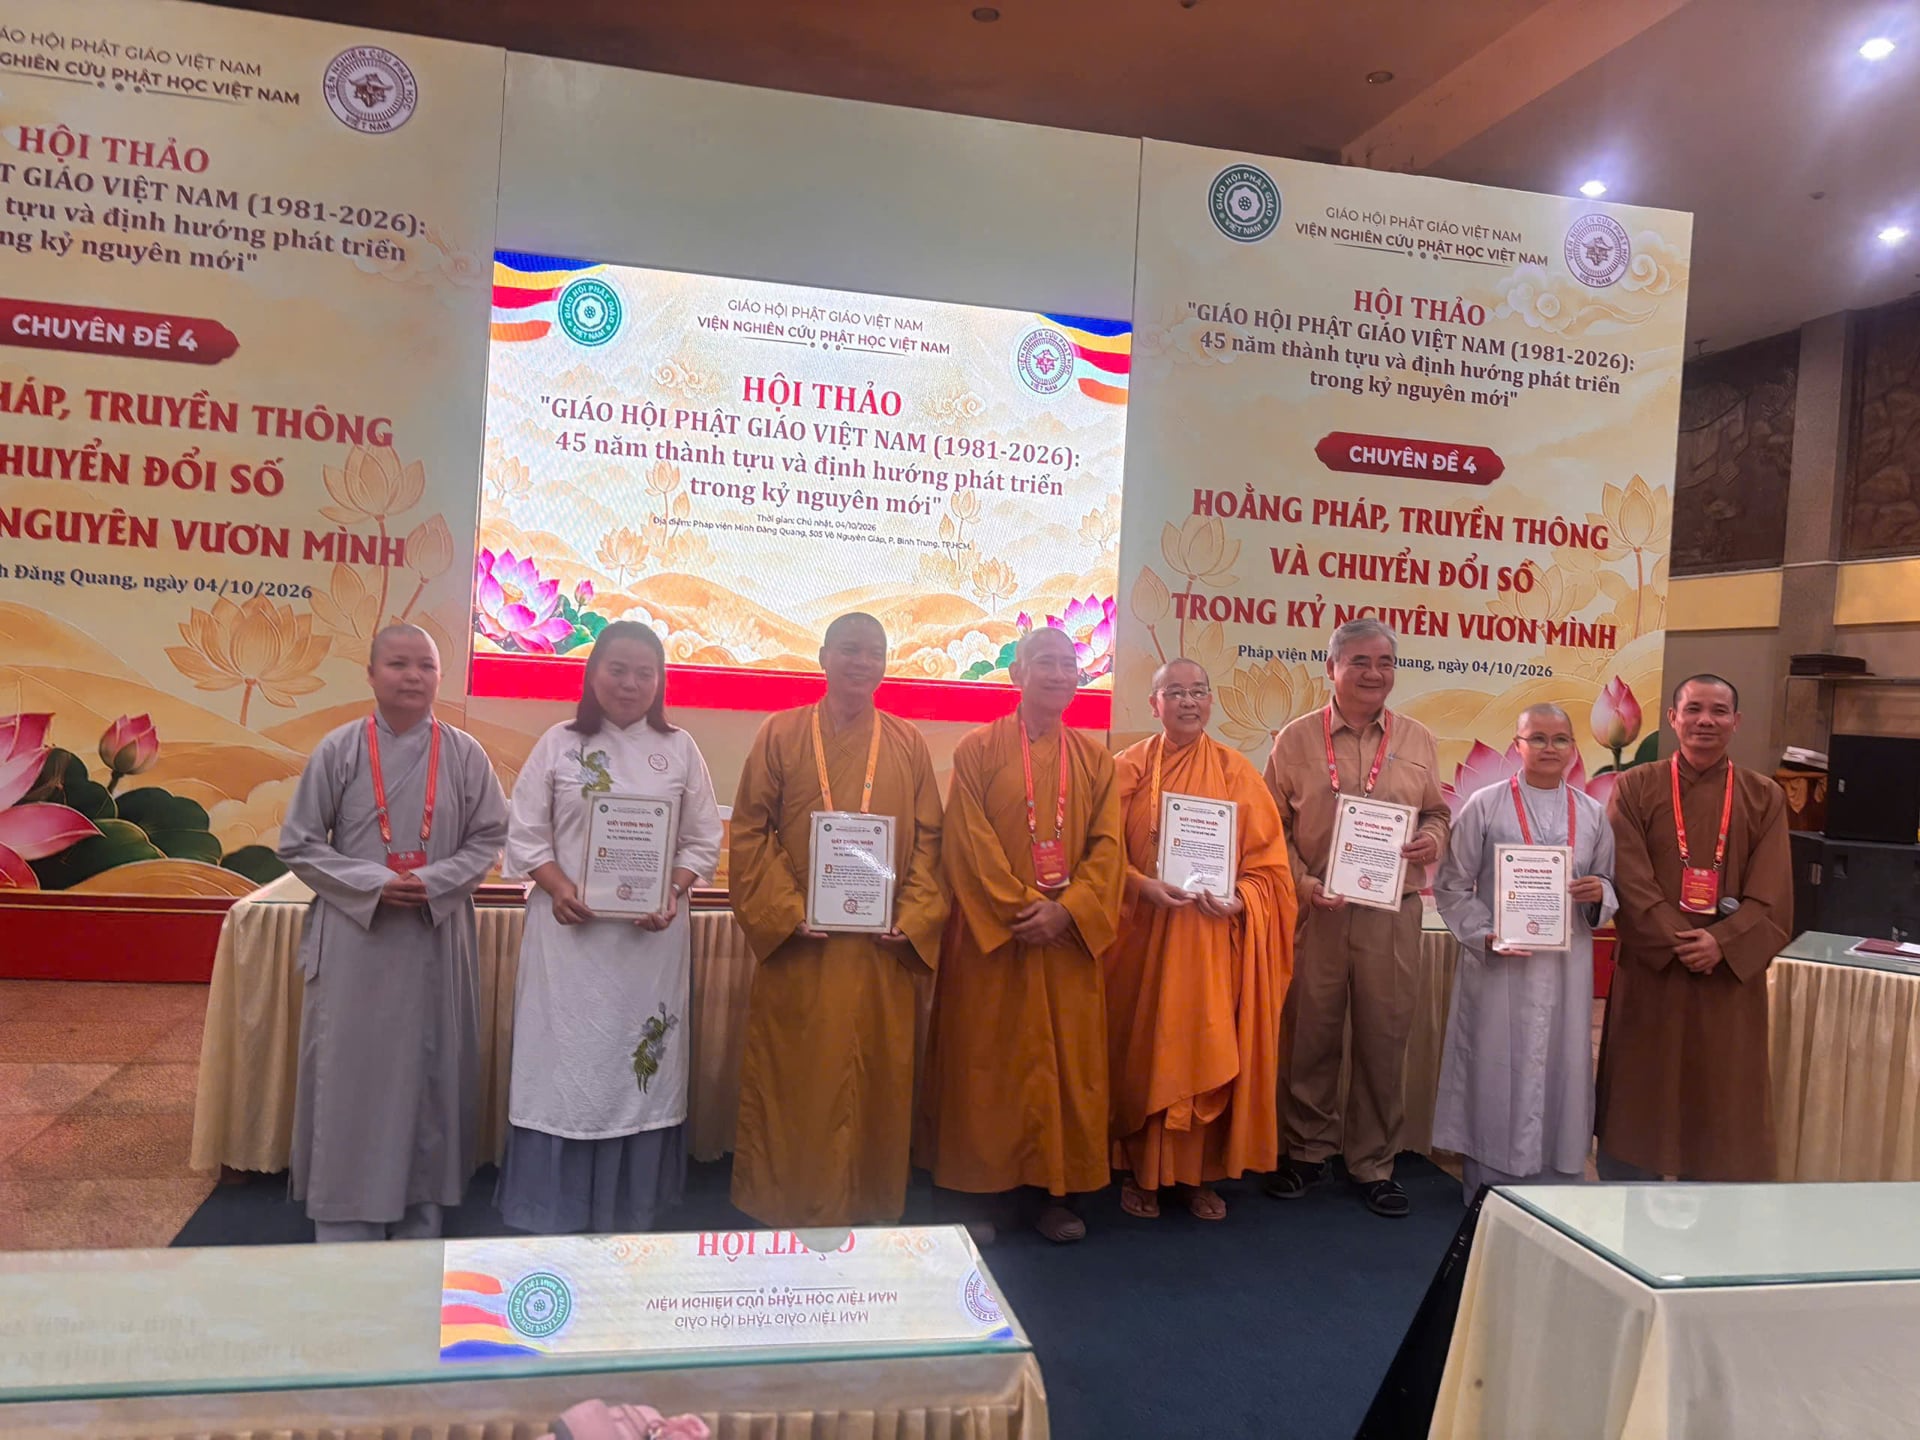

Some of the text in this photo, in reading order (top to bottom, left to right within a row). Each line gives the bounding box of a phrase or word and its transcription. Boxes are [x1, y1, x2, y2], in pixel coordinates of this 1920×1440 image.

[30, 31, 261, 77] HỘI PHẬT GIÁO VIỆT NAM
[64, 60, 106, 79] CỨU
[111, 65, 163, 87] PHẬT
[167, 74, 208, 94] HỌC
[212, 81, 254, 100] VIỆT
[257, 87, 300, 105] NAM
[18, 123, 210, 174] HỘI THẢO
[23, 165, 95, 193] GIÁO
[102, 174, 169, 205] VIỆT
[176, 184, 238, 211] NAM
[247, 193, 426, 238] (1981-2026):
[5, 196, 405, 262] tựu và định hướng phát triển
[1295, 221, 1548, 266] VIỆN NGHIÊN CỨU PHẬT HỌC VIỆT NAM
[1325, 206, 1522, 244] GIÁO HỘI PHẬT GIÁO VIỆT NAM
[40, 229, 74, 257] kỷ
[82, 239, 181, 266] nguyên
[189, 249, 258, 272] mới"
[727, 298, 923, 332] GIÁO HỘI PHẬT GIÁO VIỆT NAM
[1353, 287, 1486, 327] HỘI THẢO
[12, 313, 198, 352] CHUYÊN ĐỀ 4
[697, 314, 950, 355] VIỆN NGHIÊN CỨU PHẬT HỌC VIỆT NAM
[1188, 301, 1635, 375] "GIÁO HỘI PHẬT GIÁO VIỆT NAM (1981-2026):
[1200, 331, 1620, 395] 45 năm thành tựu và định hướng phát triển
[742, 372, 902, 417] HỘI THẢO
[1310, 370, 1518, 408] trong kỷ nguyên mới"
[84, 388, 393, 447] TRUYỀN THÔNG
[540, 394, 1080, 472] "GIÁO HỘI PHẬT GIÁO VIỆT NAM (1981-2026):
[143, 446, 217, 492] ĐỔI
[230, 457, 285, 497] SỐ
[555, 431, 1063, 496] 45 năm thành tựu và định hướng phát triển
[1349, 445, 1477, 474] CHUYÊN ĐỀ 4
[690, 477, 942, 516] trong kỷ nguyên mới"
[1192, 482, 1609, 551] HOẰNG PHÁP, TRUYỀN THÔNG
[171, 519, 290, 559] VƯƠN
[302, 525, 405, 567] MÌNH
[14, 564, 66, 586] Đăng
[69, 568, 138, 591] Quang,
[143, 574, 189, 594] ngày
[193, 577, 313, 600] 04/10/2026
[1269, 543, 1535, 594] VÀ CHUYỂN ĐỔI SỐ
[1171, 592, 1277, 625] TRONG
[1287, 593, 1327, 629] KỶ
[1457, 613, 1539, 645] VƯƠN
[1543, 615, 1617, 650] MÌNH
[1237, 644, 1553, 678] Pháp viện ngày 04/10/2026
